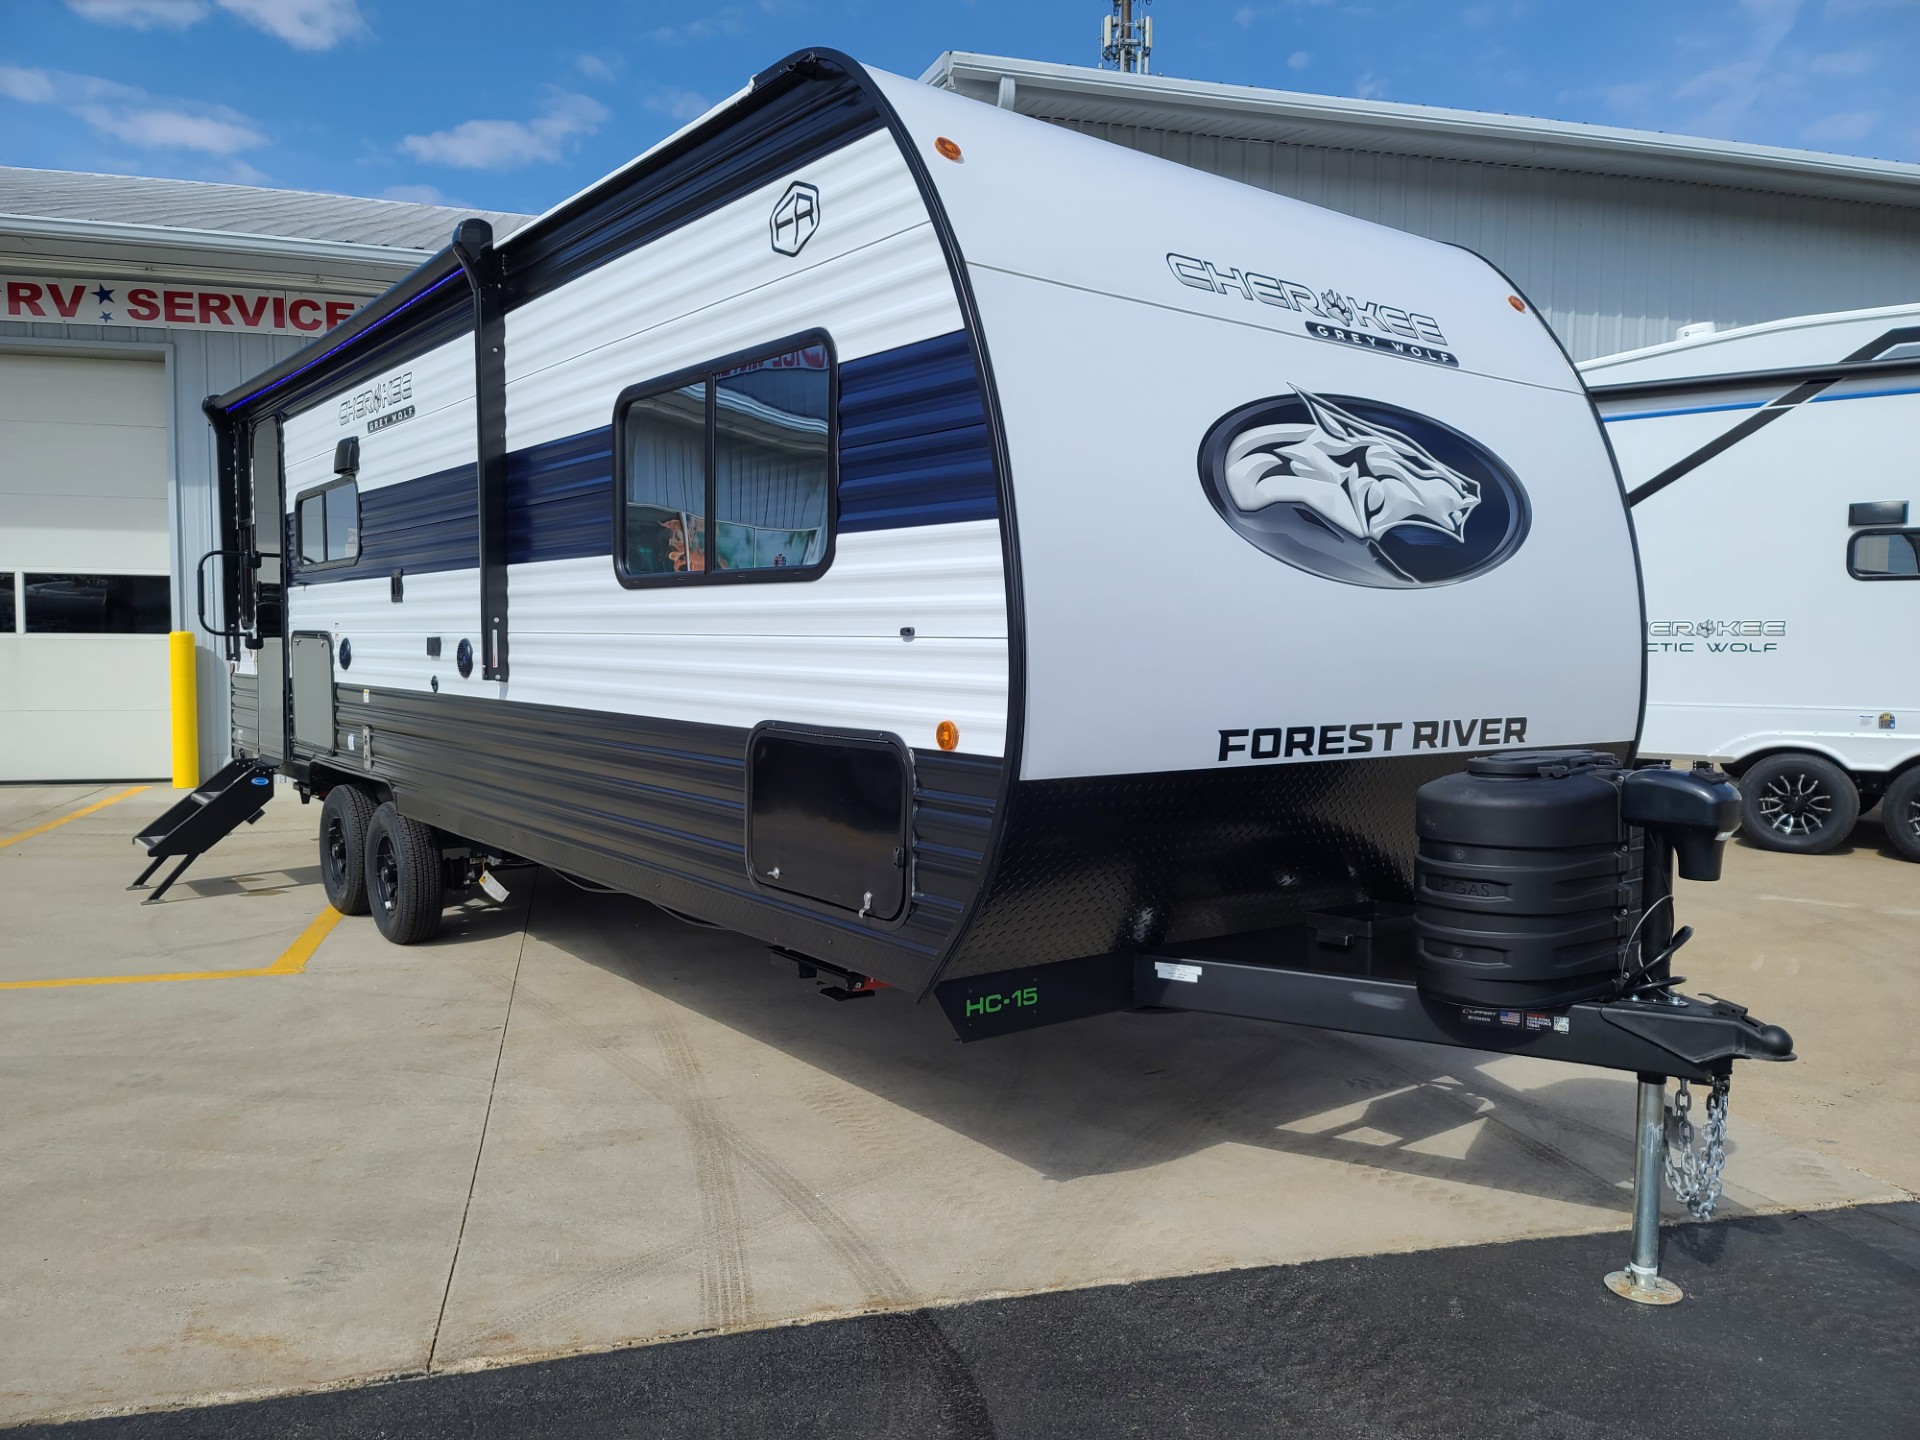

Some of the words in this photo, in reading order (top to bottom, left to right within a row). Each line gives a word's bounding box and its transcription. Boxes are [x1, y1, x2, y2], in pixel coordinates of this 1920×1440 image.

[6, 281, 86, 318] RV
[1316, 324, 1376, 348] GREY
[1391, 340, 1450, 363] WOLF
[369, 417, 389, 431] GREY
[391, 407, 413, 422] WOLF
[1706, 642, 1778, 653] WOLF
[1217, 722, 1403, 761] FOREST
[1412, 717, 1527, 750] RIVER
[1454, 881, 1490, 897] GAS
